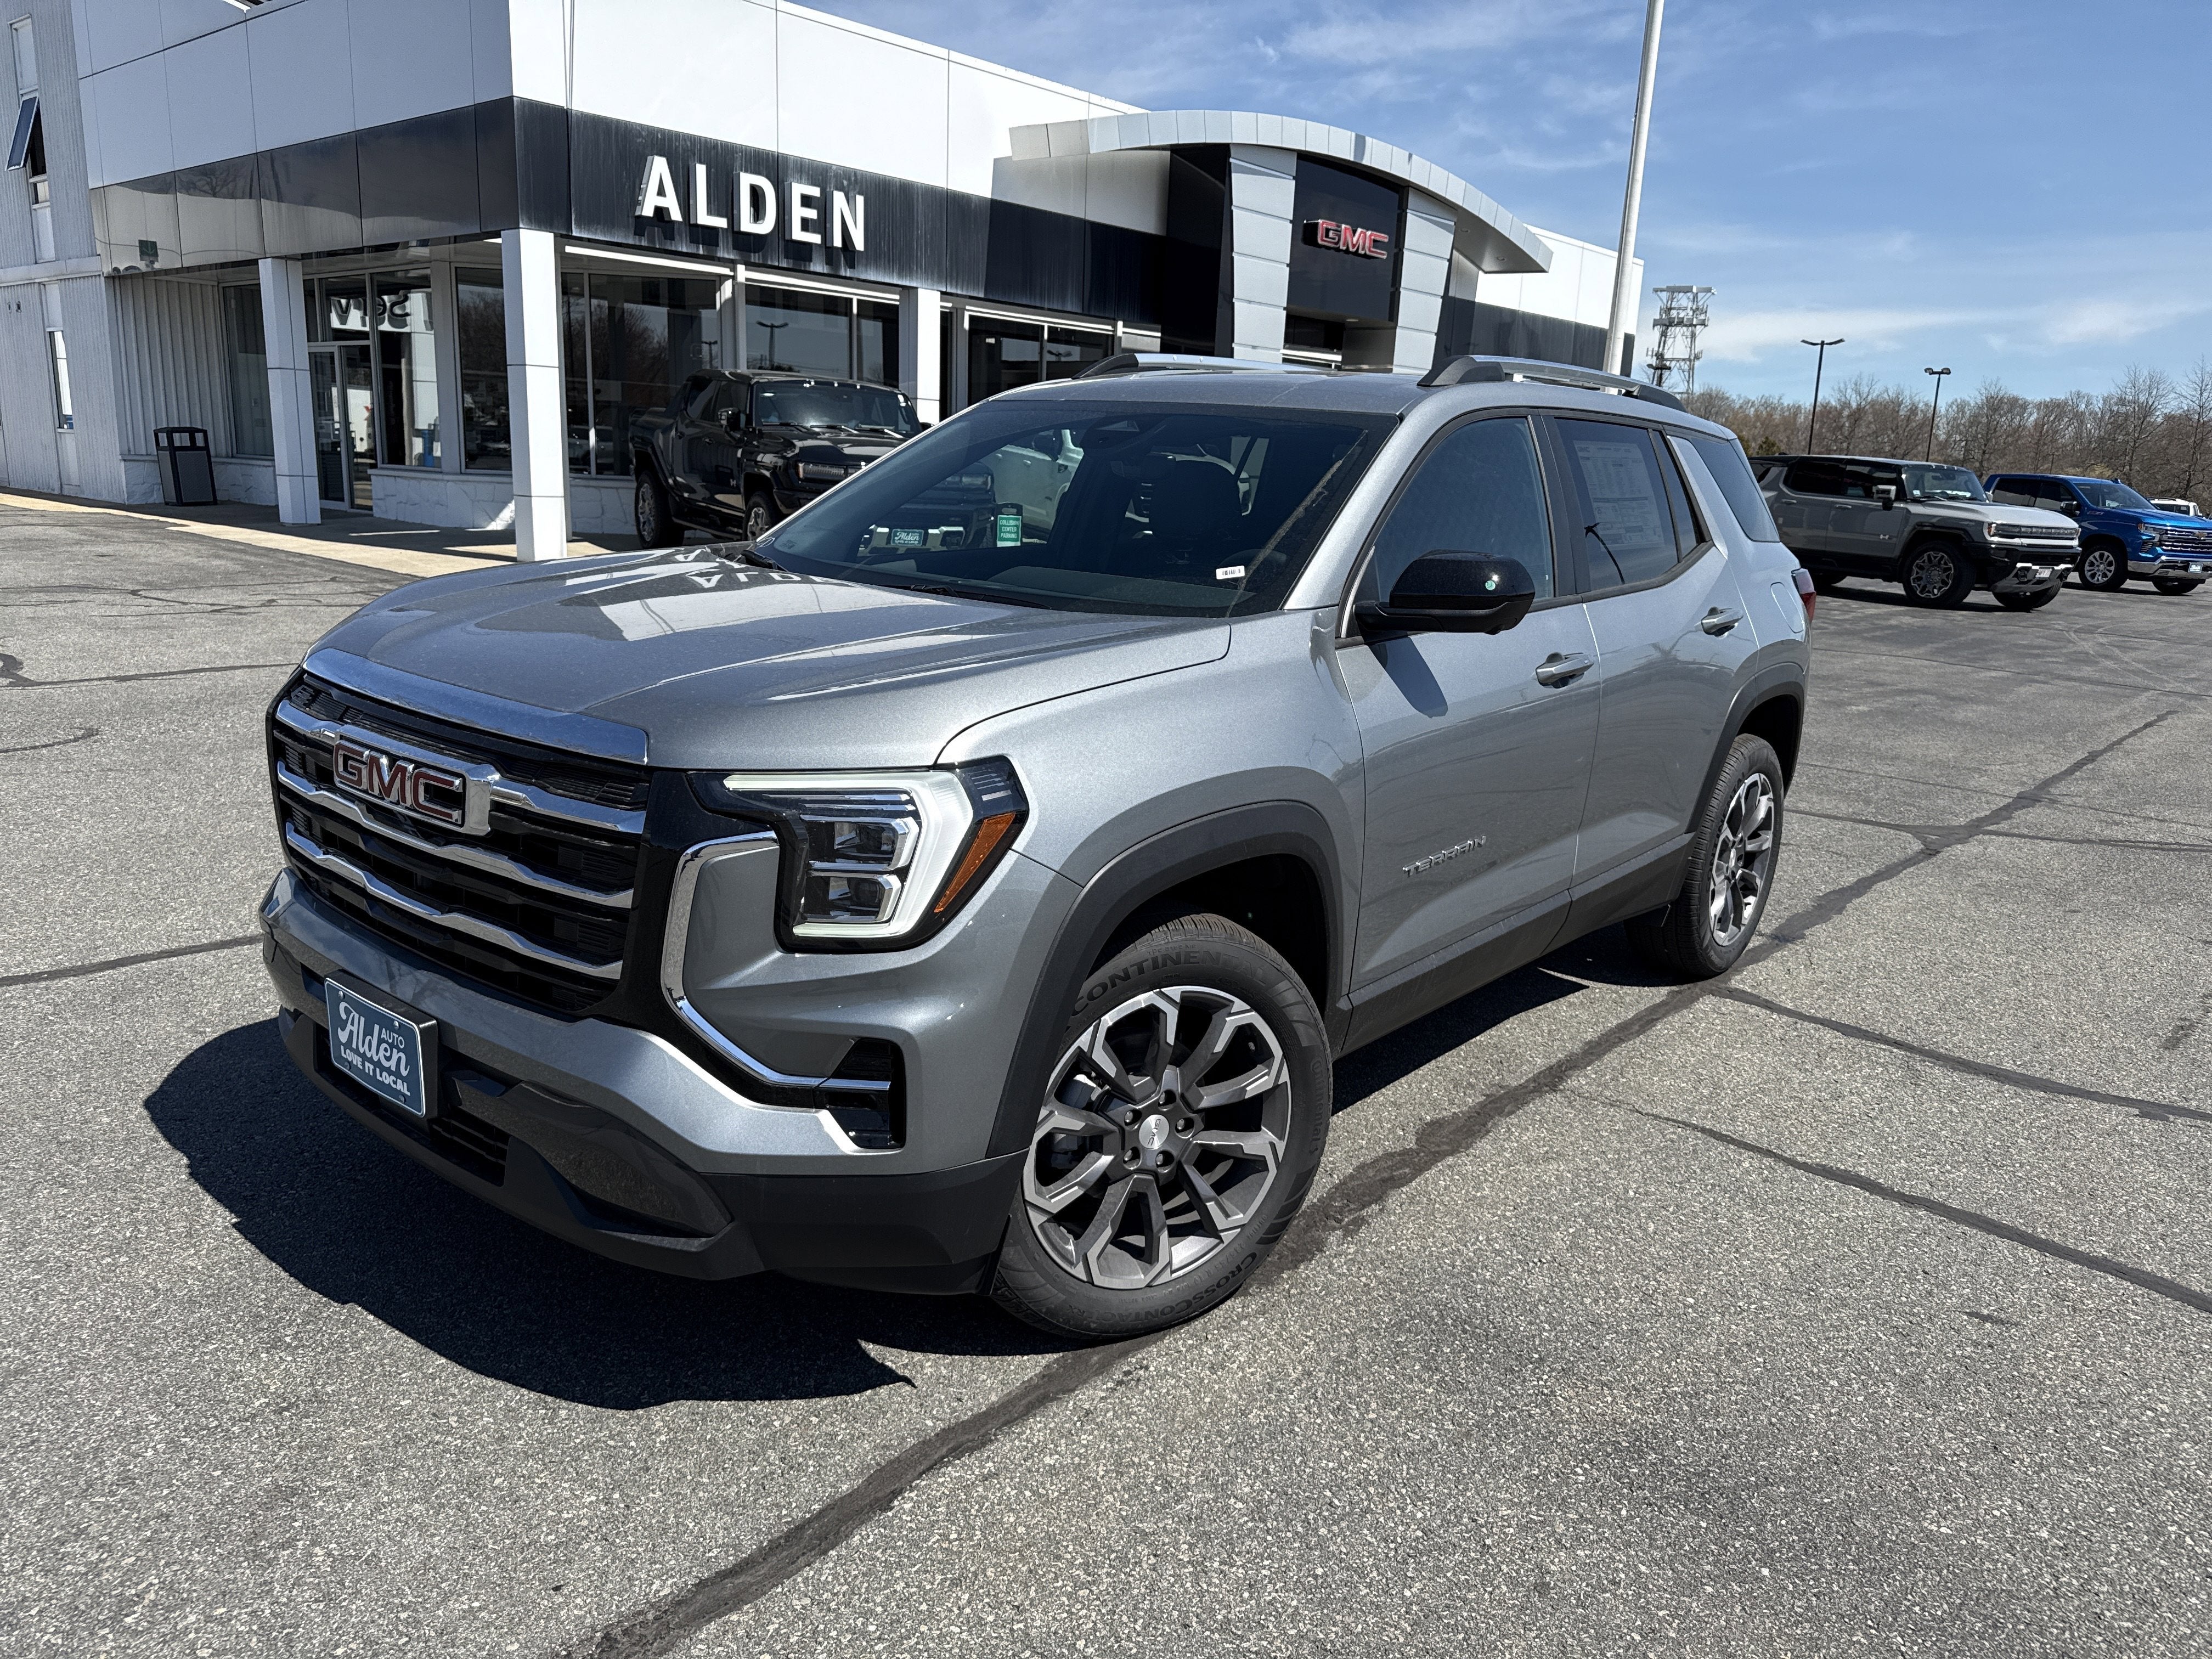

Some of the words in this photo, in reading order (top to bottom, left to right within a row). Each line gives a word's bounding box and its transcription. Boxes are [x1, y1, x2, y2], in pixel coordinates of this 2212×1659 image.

[635, 155, 864, 251] ALDEN
[1318, 219, 1389, 259] GMC
[895, 532, 919, 540] Alden
[334, 740, 463, 825] GMC
[1402, 835, 1487, 877] TERRAIN
[337, 1001, 410, 1077] Alden
[381, 1028, 405, 1049] AUTO
[340, 1045, 363, 1069] LOVE
[365, 1060, 374, 1076] IT
[376, 1067, 411, 1096] LOCAL
[1147, 1118, 1161, 1146] GMC
